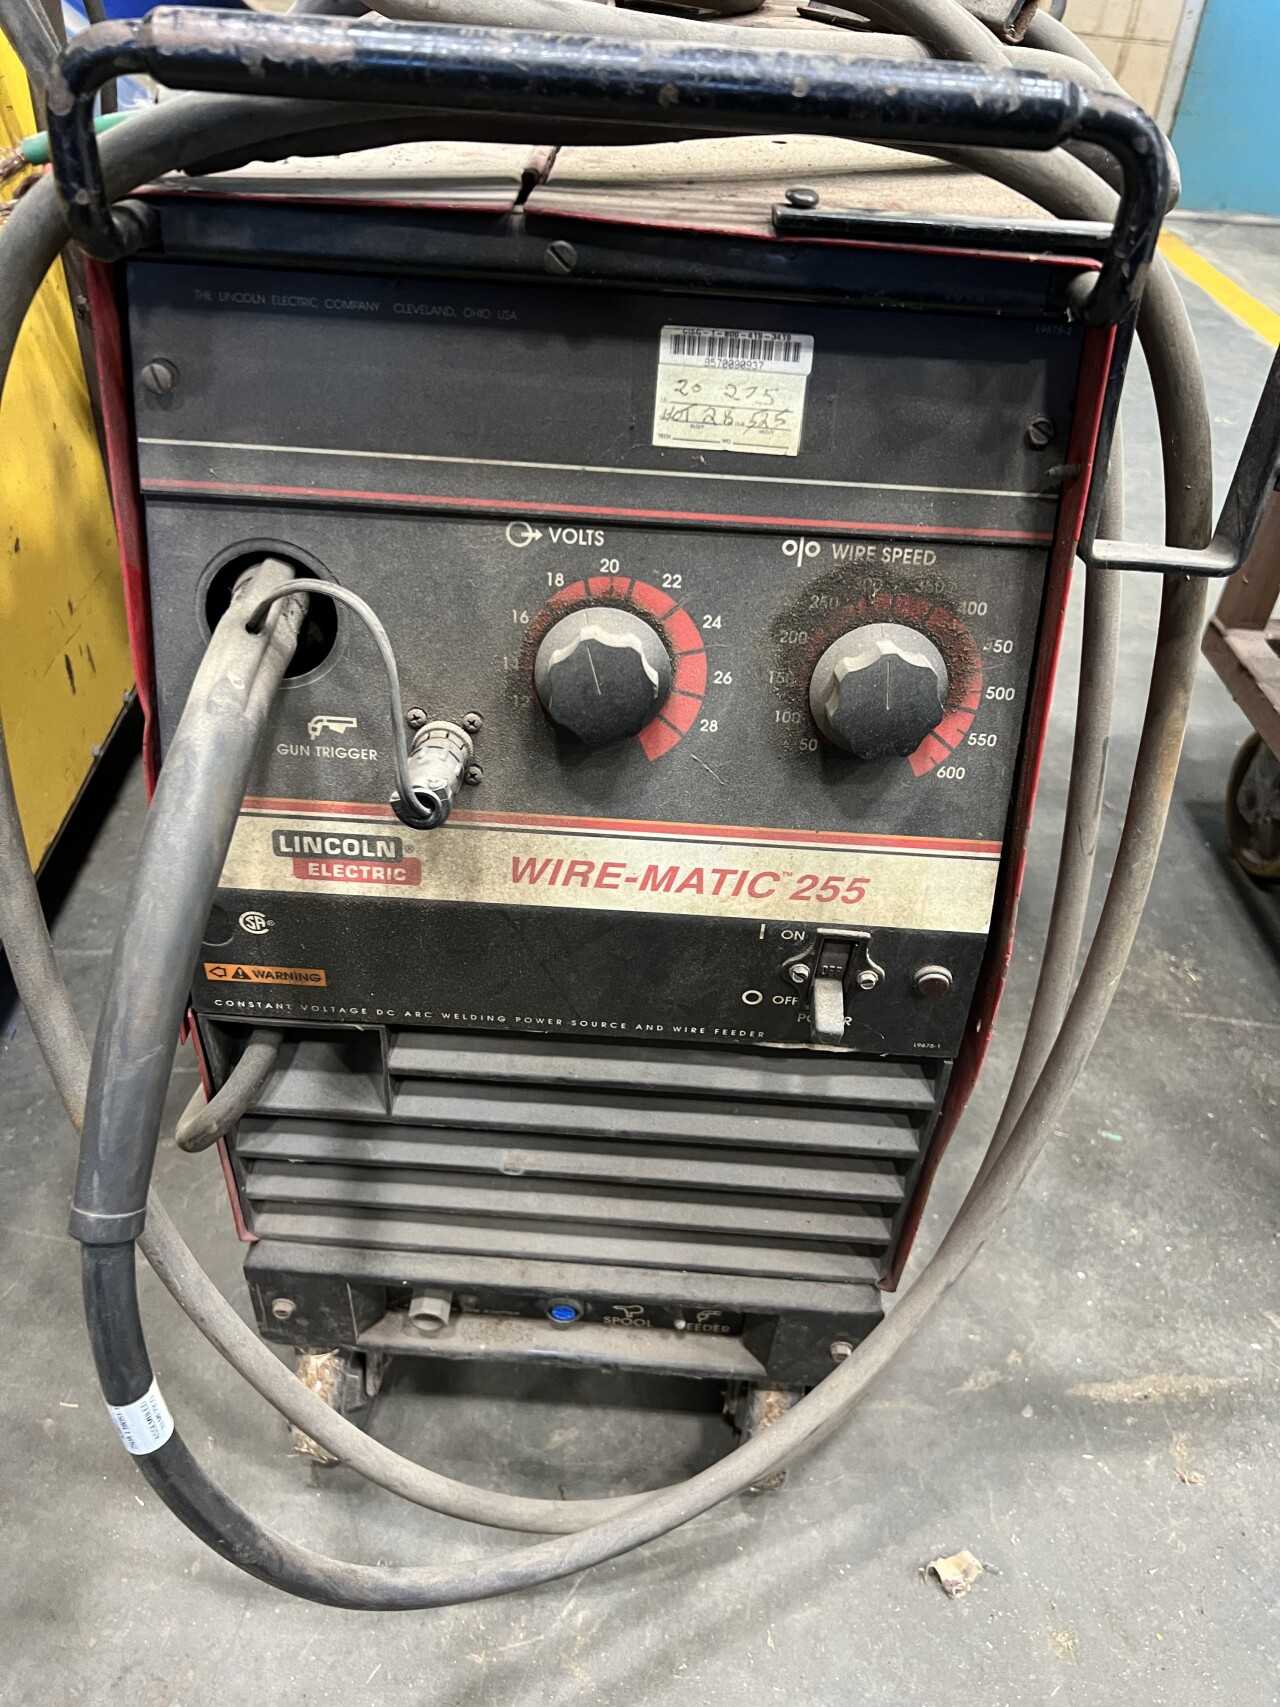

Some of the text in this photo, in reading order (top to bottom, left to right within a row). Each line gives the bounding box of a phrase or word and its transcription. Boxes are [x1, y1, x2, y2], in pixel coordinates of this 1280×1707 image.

[218, 291, 266, 304] LINCOLN
[271, 294, 318, 308] ELECTRIC
[324, 297, 380, 312] COMPANY
[463, 306, 490, 319] OHIO
[674, 379, 702, 397] 20
[548, 527, 605, 547] VOLTS
[831, 543, 937, 566] WIRE SPEED
[600, 558, 620, 574] 20
[547, 572, 564, 587] 18
[662, 573, 682, 589] 22
[512, 609, 529, 624] 16
[702, 615, 722, 630] 24
[983, 639, 1014, 654] 50
[713, 671, 733, 685] 26
[985, 686, 1016, 701] 500
[775, 710, 802, 723] 100
[700, 719, 718, 733] 28
[800, 738, 818, 751] 50
[967, 733, 998, 747] 550
[276, 743, 379, 761] GUN TRIGGER
[936, 766, 966, 780] 600
[278, 834, 397, 859] LINCOLN
[307, 862, 408, 882] ELECTRIC
[790, 873, 871, 905] 255
[781, 929, 806, 941] ON
[252, 969, 322, 983] WARNING
[772, 994, 799, 1006] OFF
[213, 999, 765, 1039] CONSTANT VOLTAGE DC ARC WELDING POWER SOURCE AND WIRE FEEDER
